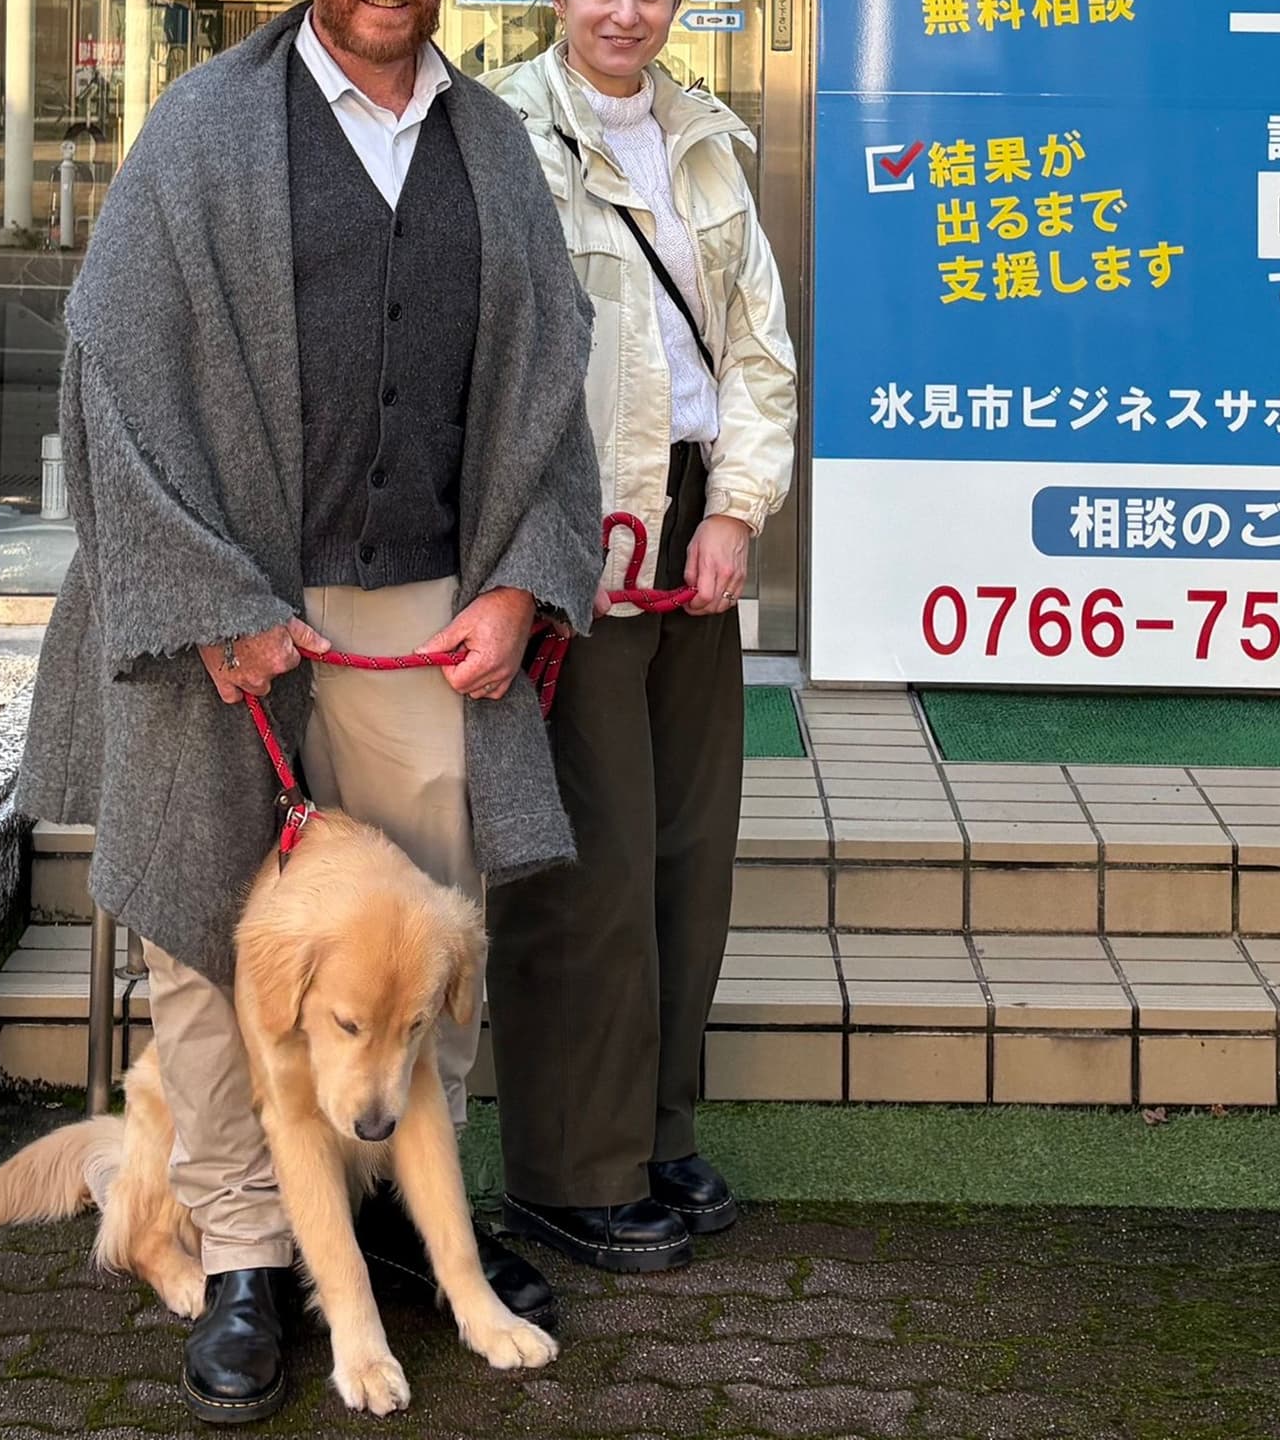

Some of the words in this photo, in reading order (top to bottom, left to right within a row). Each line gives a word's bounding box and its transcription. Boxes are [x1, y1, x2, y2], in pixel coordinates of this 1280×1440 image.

[928, 131, 1086, 189] 結果が
[936, 188, 1128, 246] 出るまで
[937, 242, 1185, 305] 支援します
